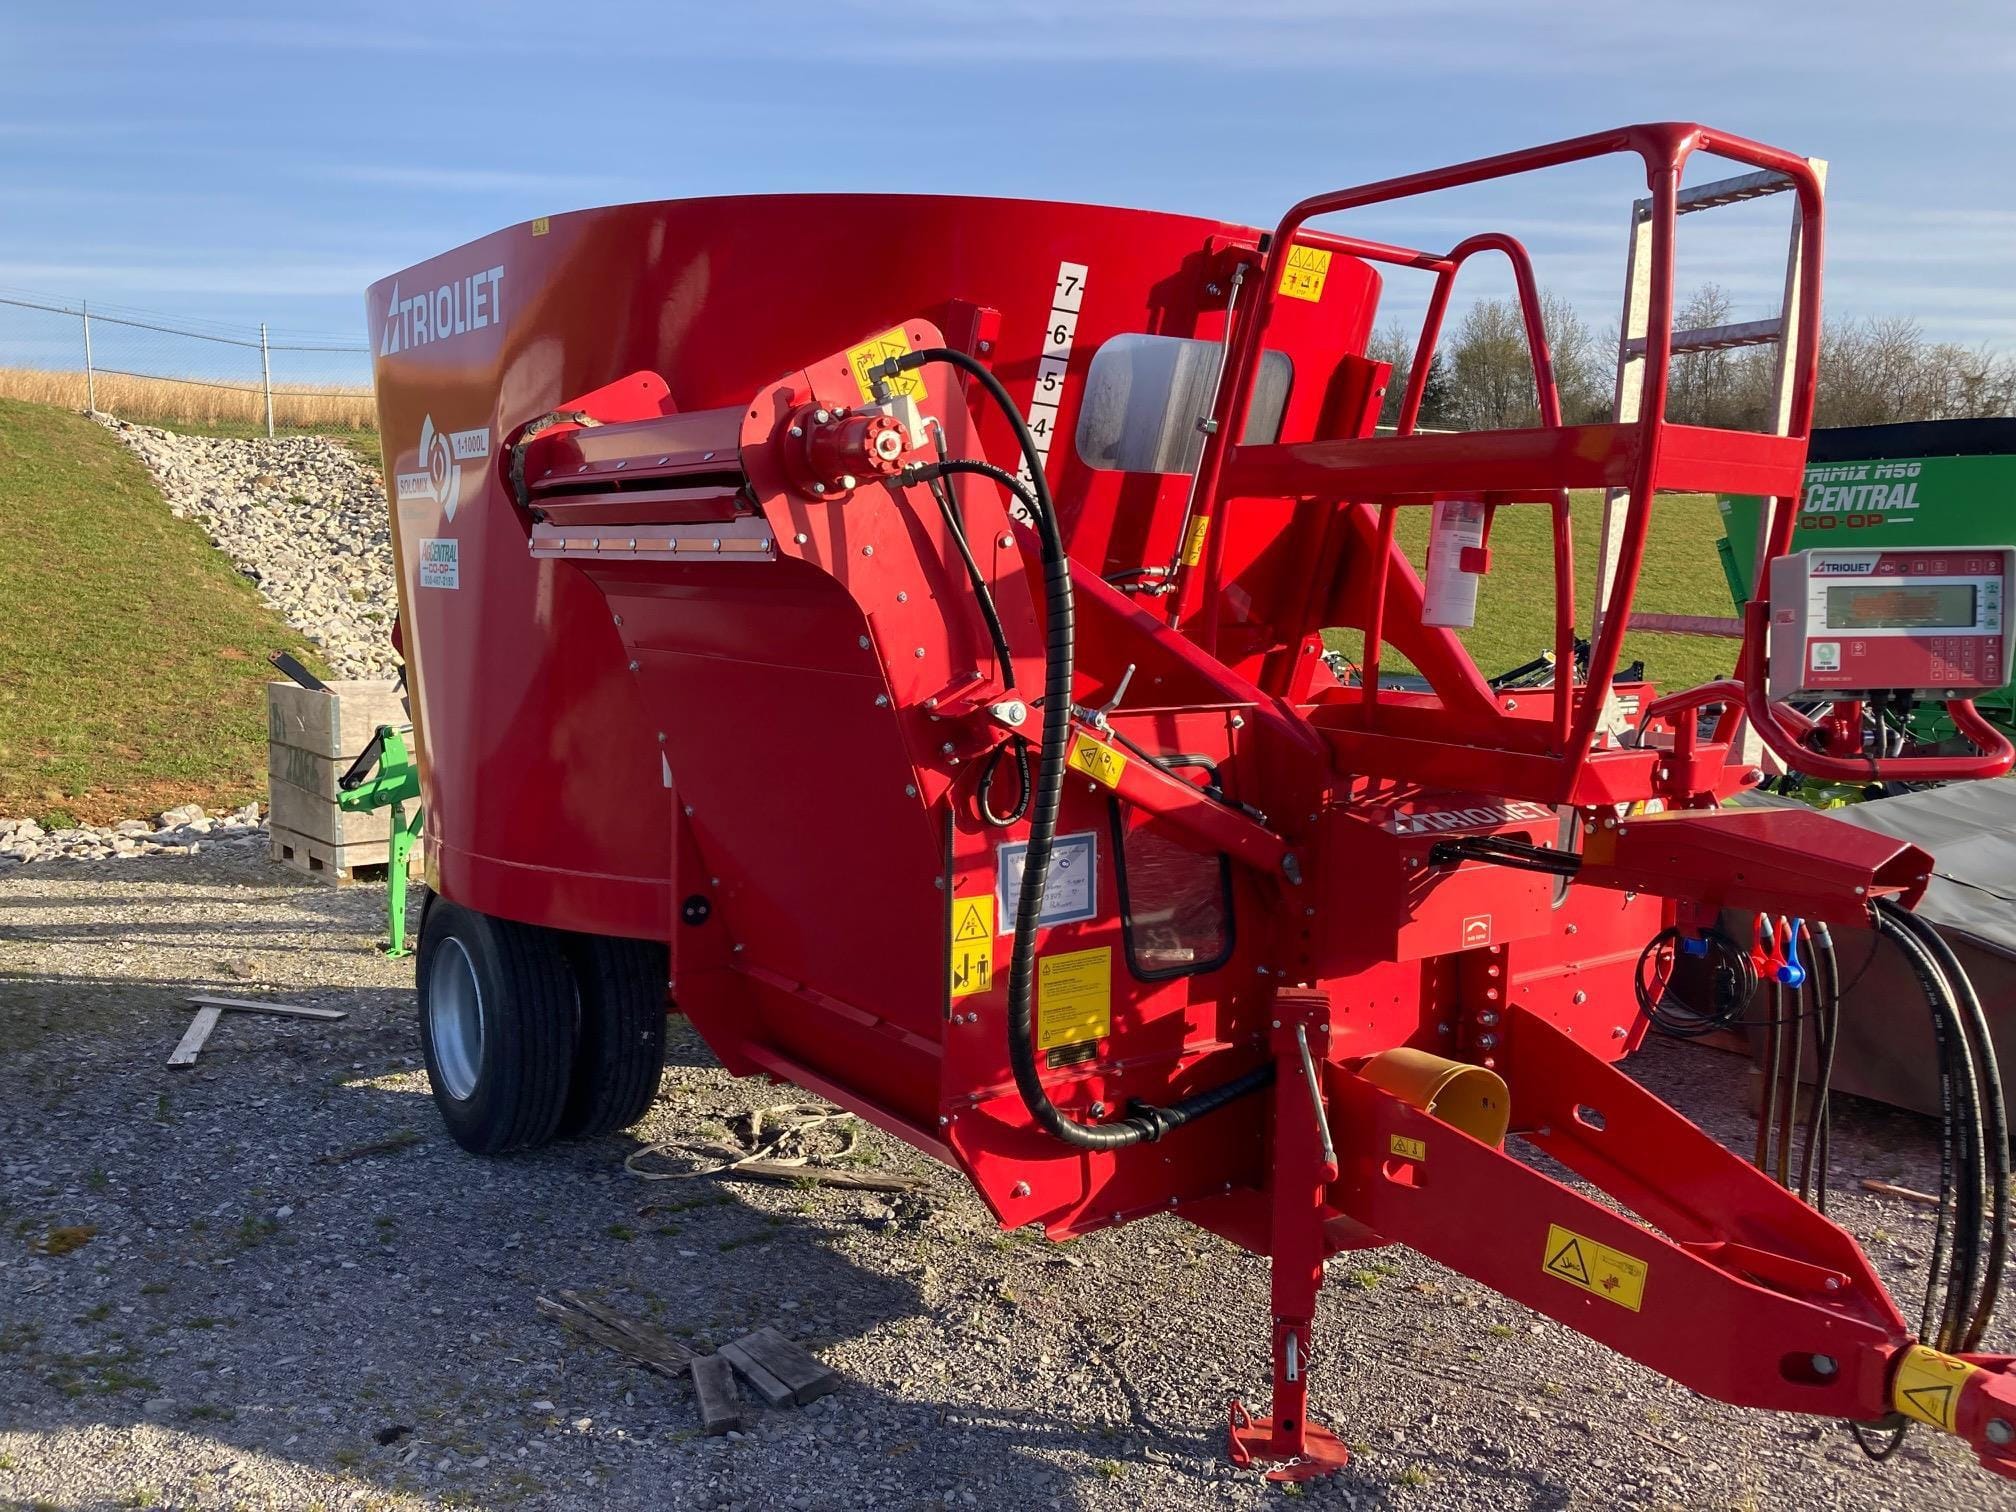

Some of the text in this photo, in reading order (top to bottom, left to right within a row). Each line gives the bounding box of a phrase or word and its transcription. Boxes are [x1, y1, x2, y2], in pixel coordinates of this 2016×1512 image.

[1064, 276, 1079, 296] 7
[400, 264, 504, 350] TRIOLIET
[1053, 324, 1067, 345] 6
[1043, 371, 1058, 391] 5
[1034, 418, 1047, 437] 4
[1874, 463, 1922, 479] M50
[400, 476, 429, 495] SOLOMIX
[428, 563, 449, 575] CO-OP
[1825, 563, 1871, 572] TRIOLIET
[1414, 801, 1551, 832] TRIOLIET
